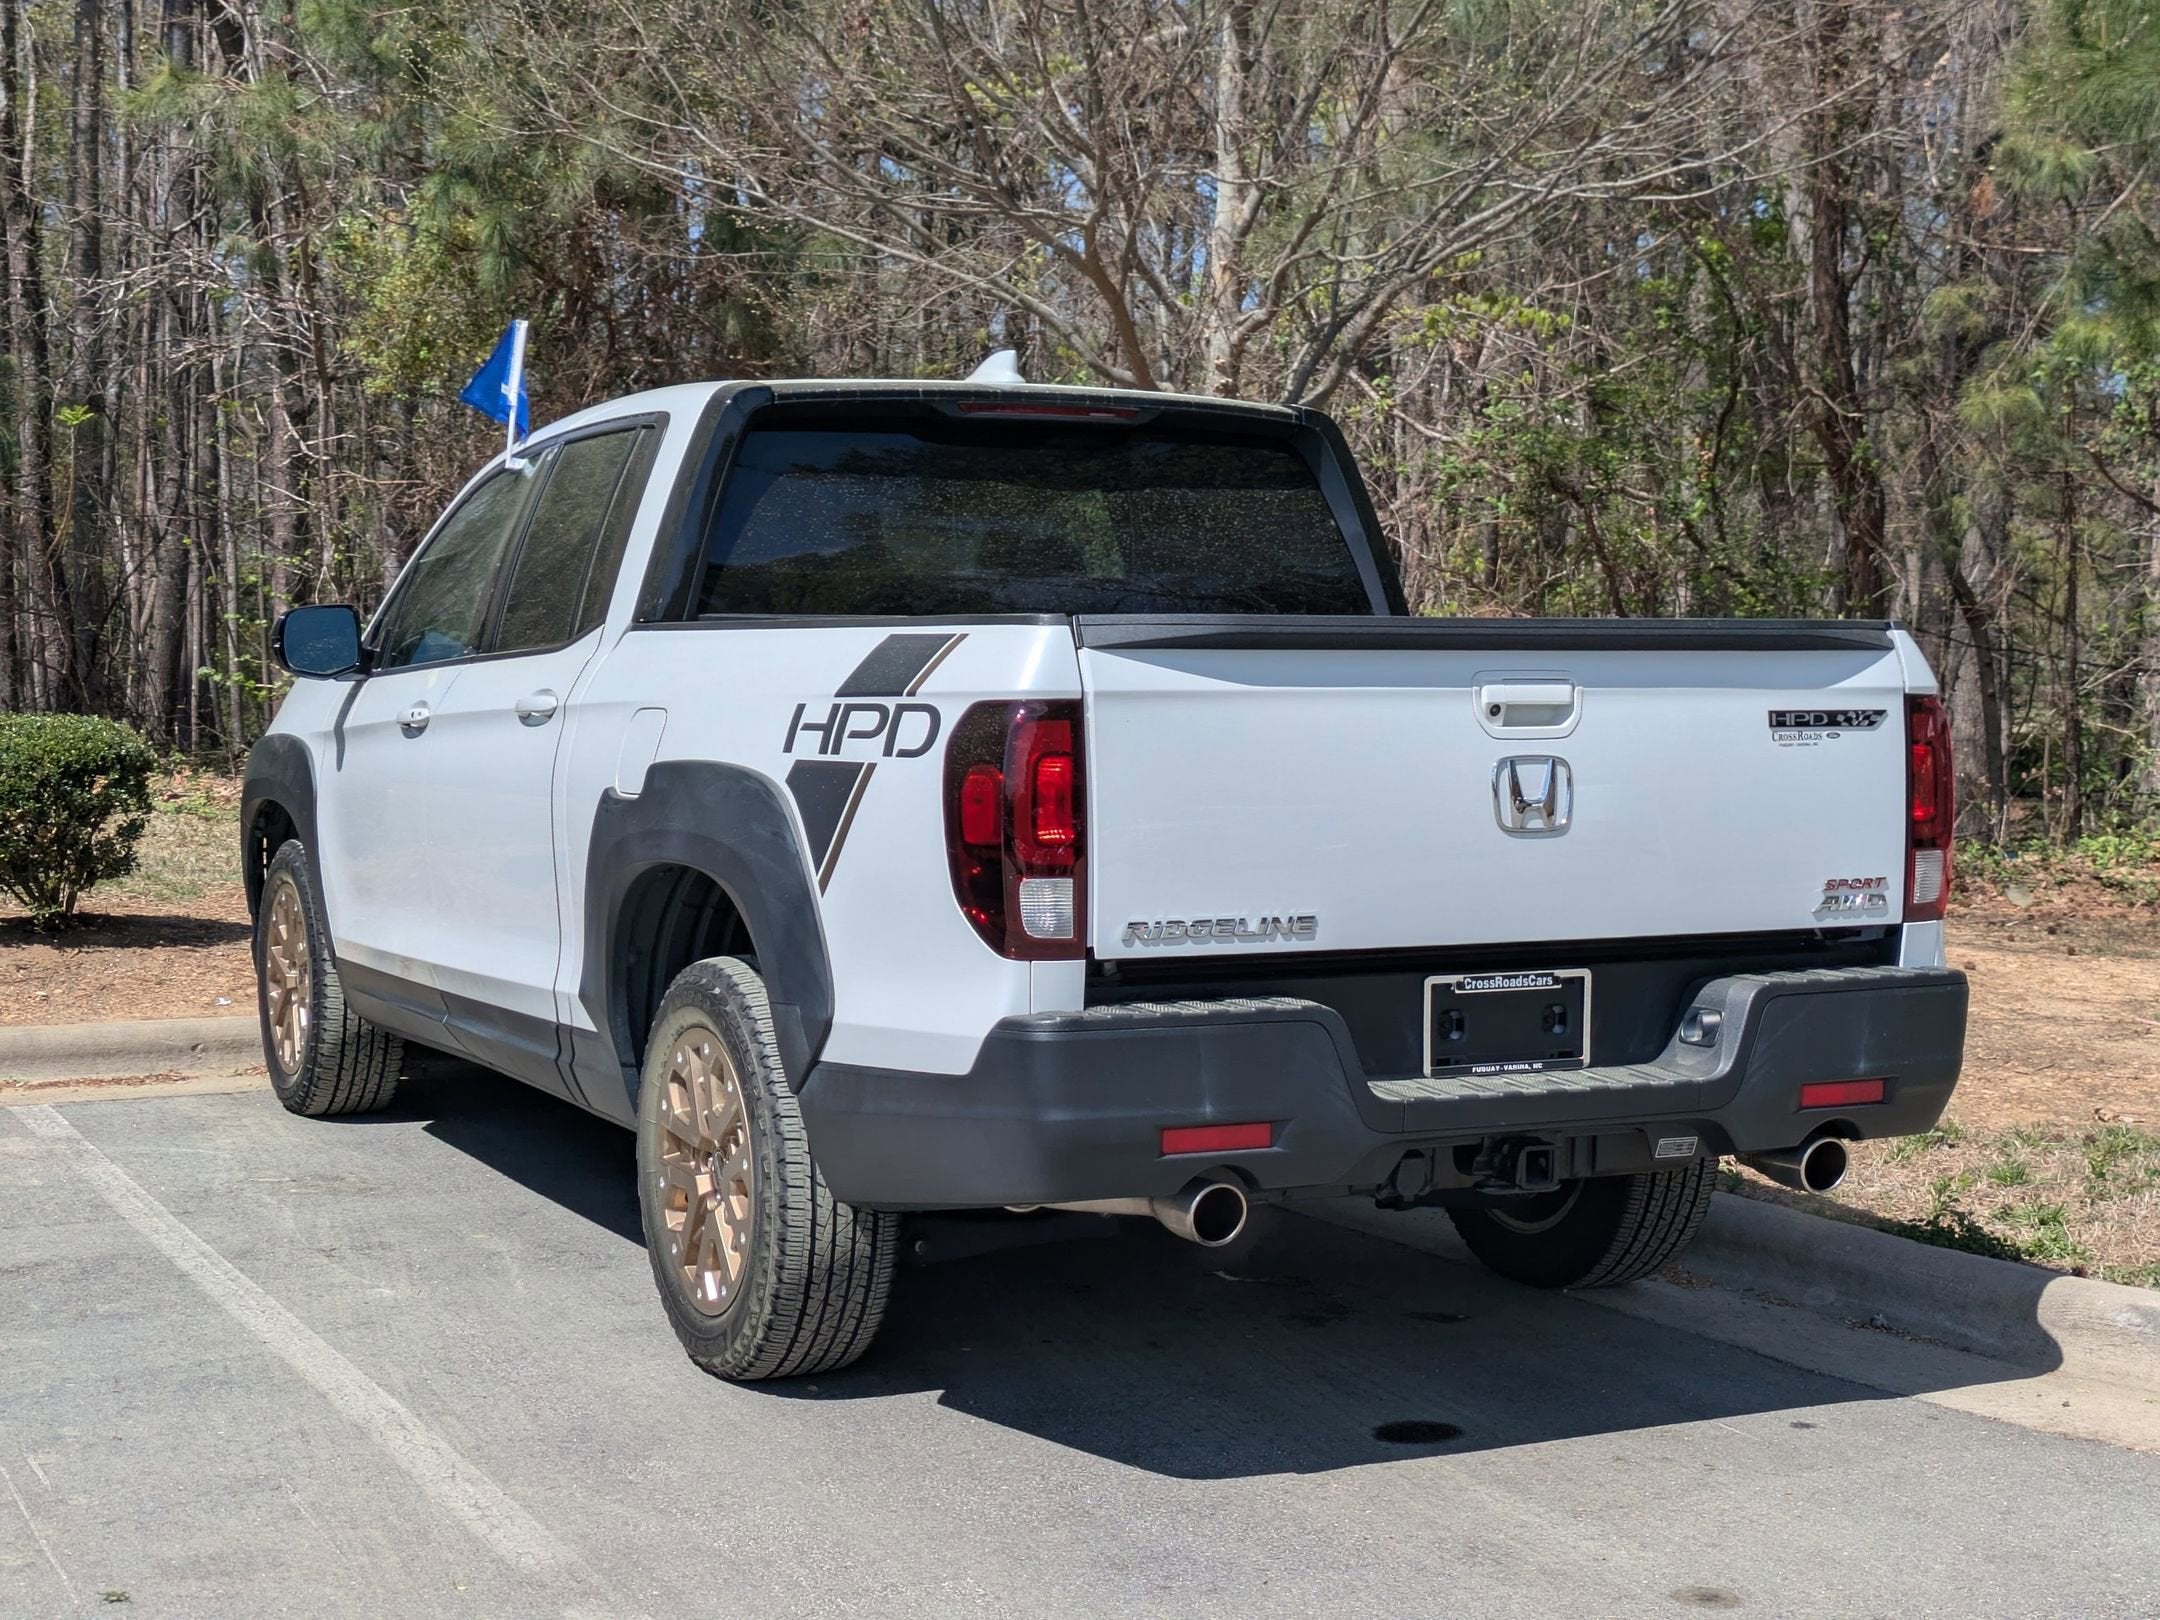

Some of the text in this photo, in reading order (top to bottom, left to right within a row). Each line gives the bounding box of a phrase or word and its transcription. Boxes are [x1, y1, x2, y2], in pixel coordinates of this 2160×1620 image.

[1771, 711, 1829, 726] HPD
[782, 702, 942, 758] HPD
[1823, 876, 1887, 891] SPORT
[1121, 914, 1317, 942] RIDGELINE
[1464, 975, 1553, 990] CrossRoadsCars
